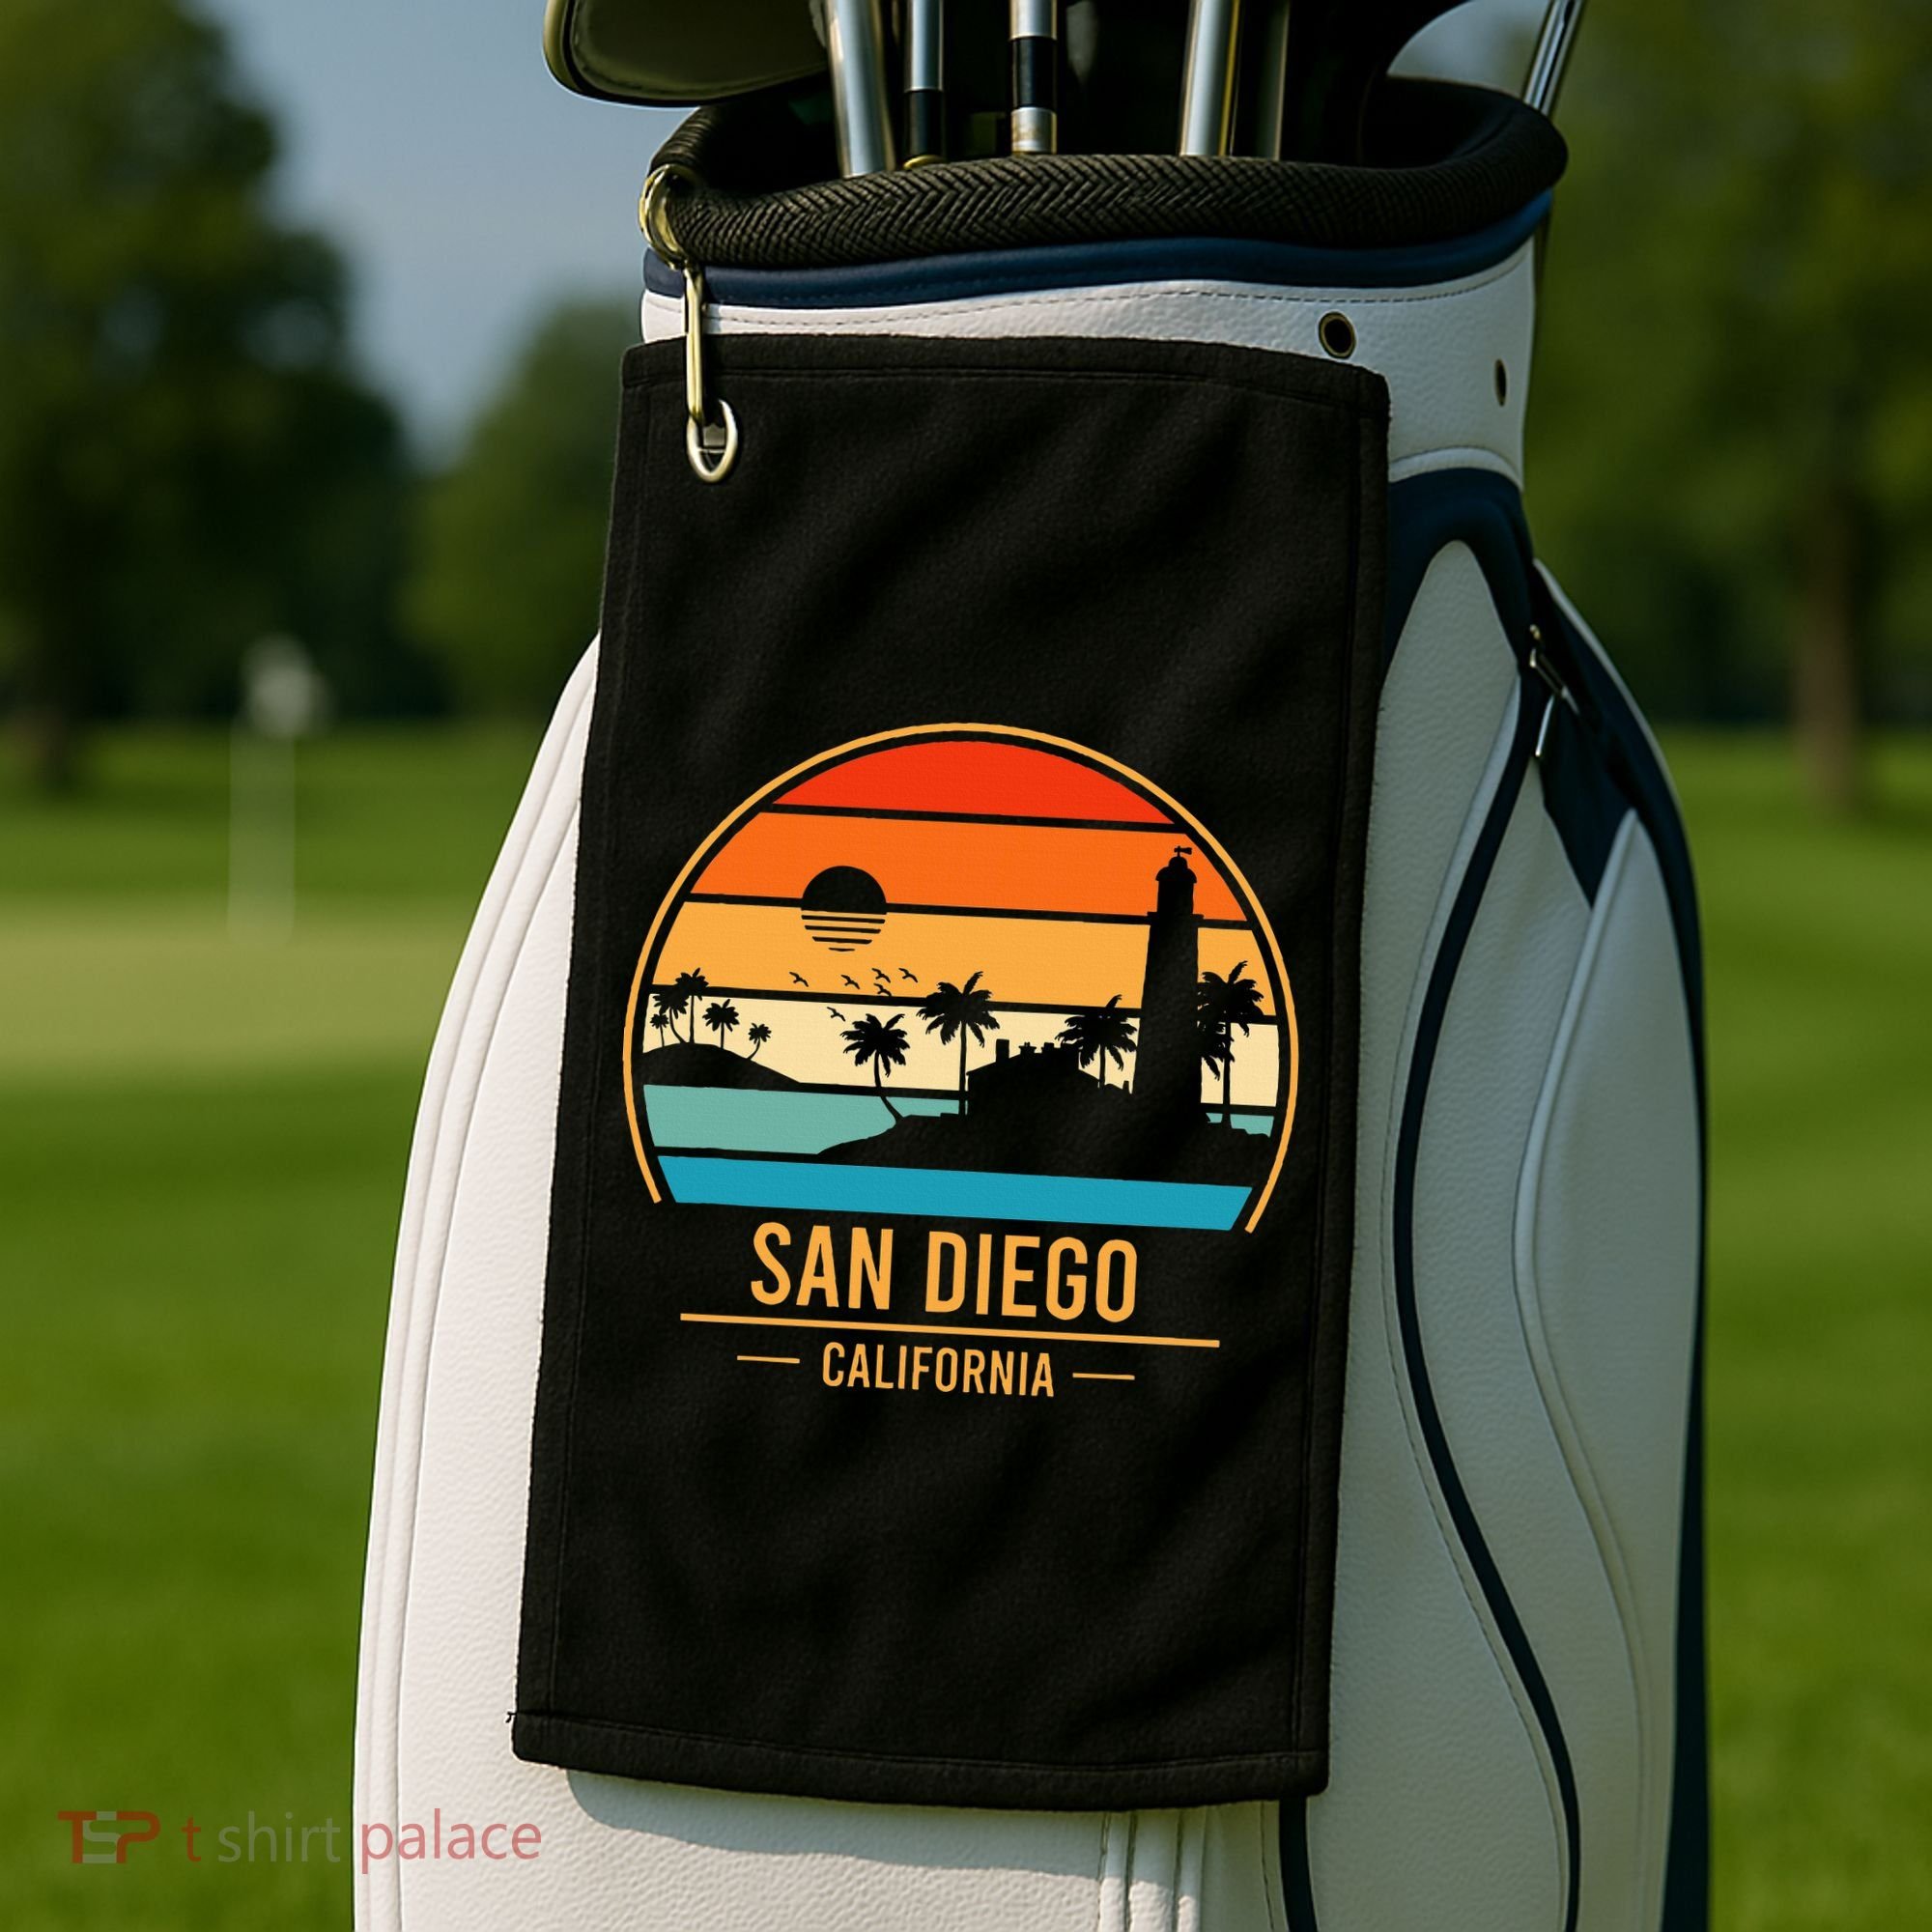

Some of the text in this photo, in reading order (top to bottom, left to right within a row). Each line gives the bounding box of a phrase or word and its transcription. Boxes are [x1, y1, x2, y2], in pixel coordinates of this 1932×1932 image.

[751, 1221, 1138, 1323] SAN DIEGO
[822, 1341, 1055, 1398] CALIFORNIA
